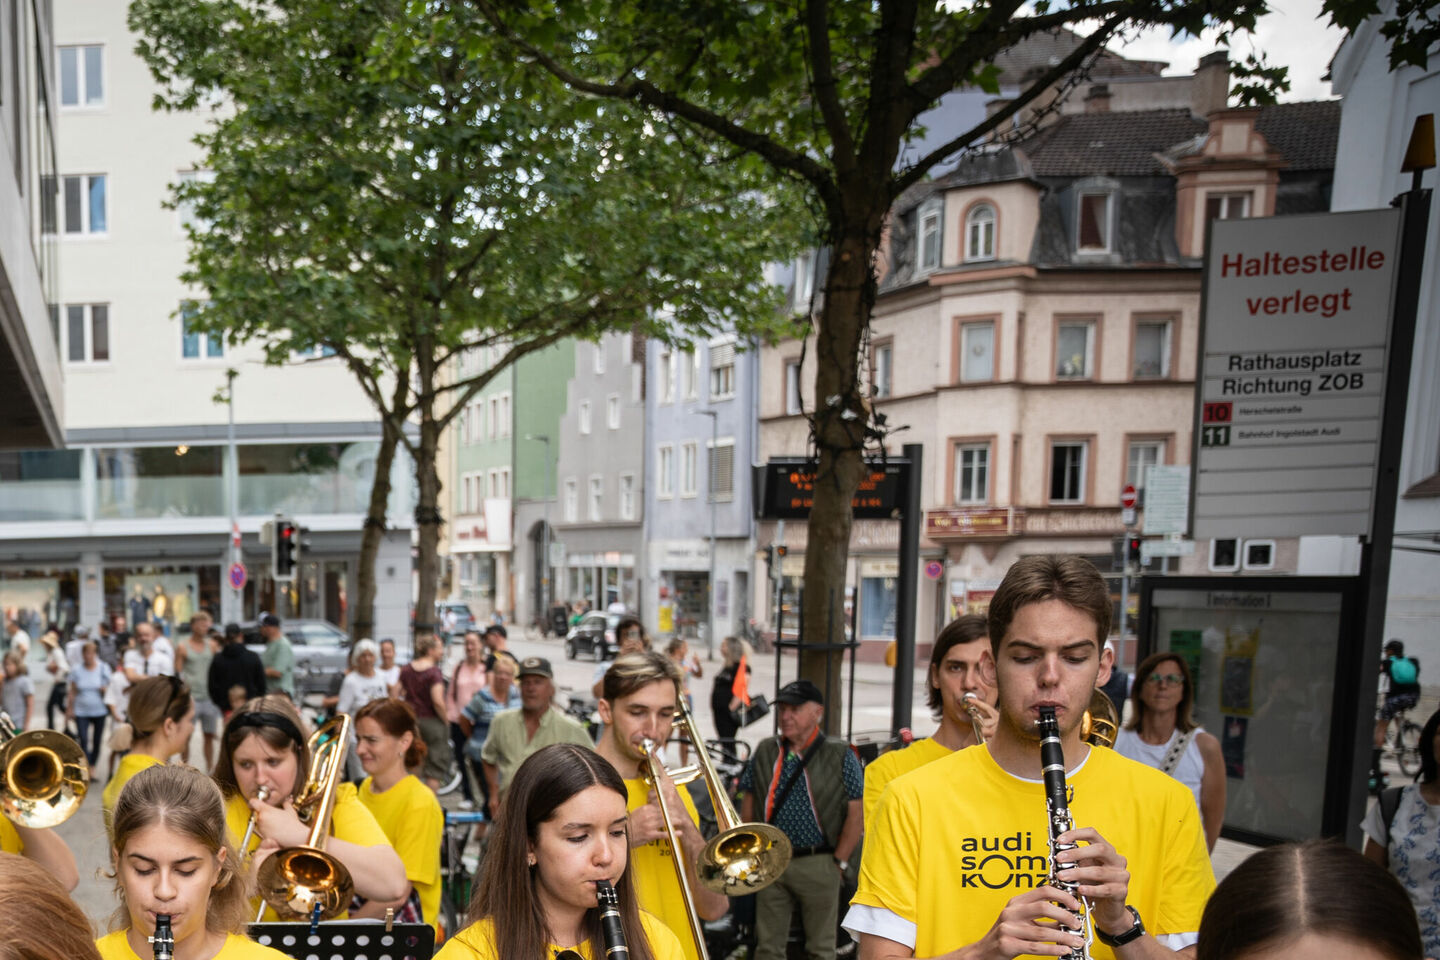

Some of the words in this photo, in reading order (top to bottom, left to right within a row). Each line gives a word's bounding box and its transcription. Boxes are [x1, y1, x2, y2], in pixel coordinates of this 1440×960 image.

[1221, 246, 1385, 278] Haltestelle
[1246, 288, 1352, 317] verlegt
[1228, 350, 1362, 374] Rathausplatz
[1222, 375, 1312, 397] Richtung
[1318, 373, 1364, 391] ZOB
[1206, 405, 1229, 421] 10
[1205, 428, 1228, 446] 11
[961, 832, 1032, 852] audi
[961, 854, 1047, 871] som
[961, 872, 1050, 889] konz
